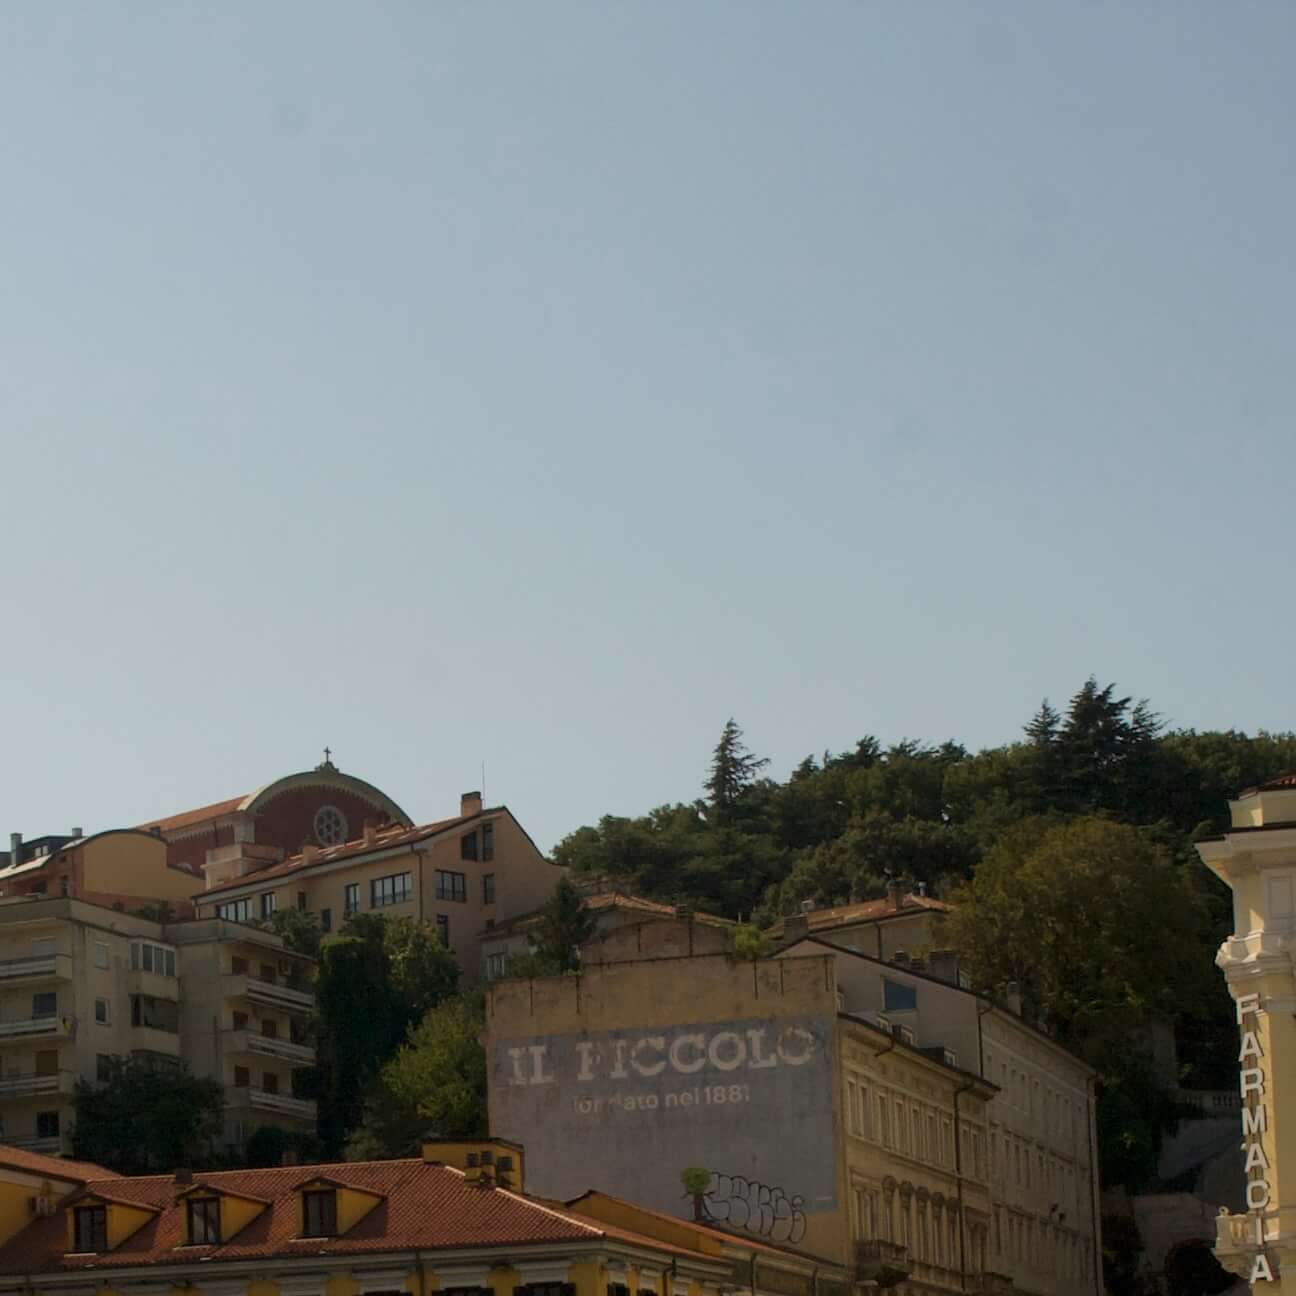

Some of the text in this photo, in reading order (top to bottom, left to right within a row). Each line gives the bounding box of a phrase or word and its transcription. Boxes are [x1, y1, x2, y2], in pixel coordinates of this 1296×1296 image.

[507, 1025, 817, 1086] IL PICCOLO
[1235, 993, 1275, 1284] FARMACIA
